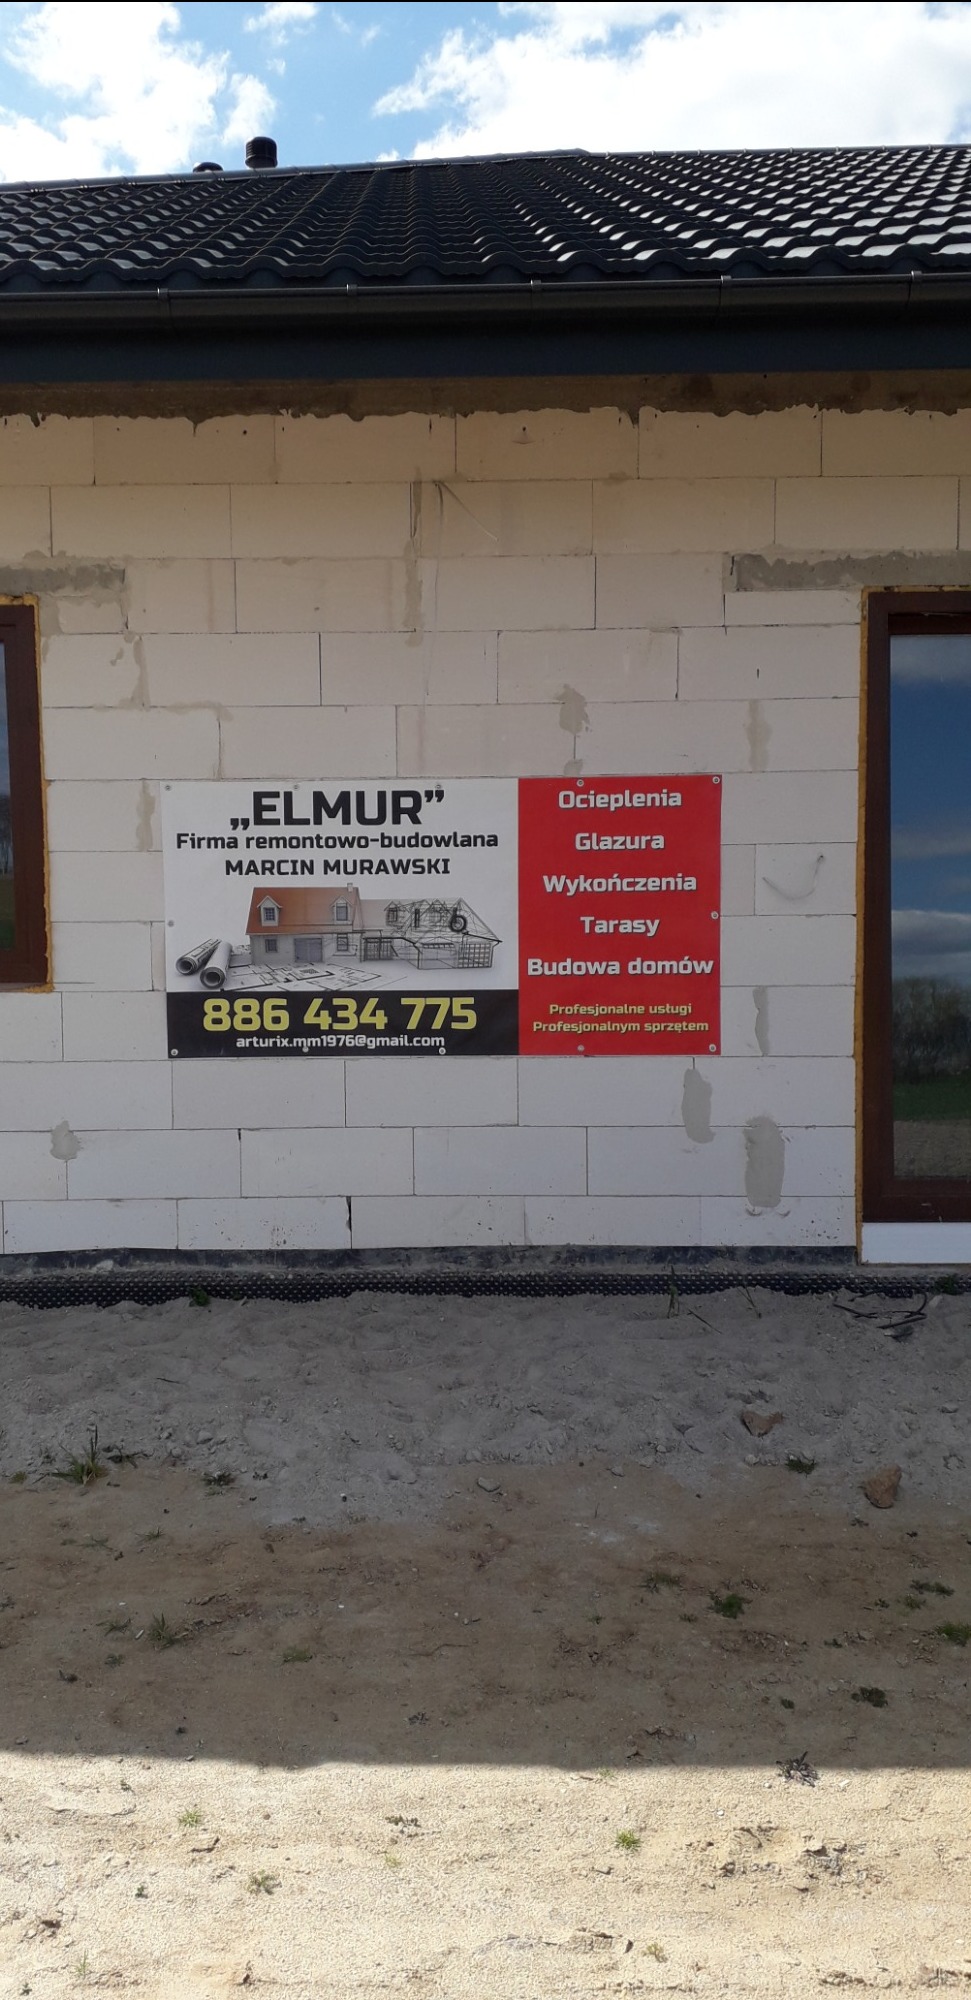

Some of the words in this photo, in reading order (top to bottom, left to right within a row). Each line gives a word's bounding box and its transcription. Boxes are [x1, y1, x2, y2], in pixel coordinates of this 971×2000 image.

[558, 789, 682, 812] Ocieplenia
[176, 833, 239, 850] Firma
[245, 831, 499, 850] remontowo-budowlana
[575, 833, 665, 851] Glazura
[225, 859, 315, 876] MARCIN
[323, 858, 451, 875] MURAWSKI
[543, 873, 697, 896] Wykończenia
[580, 916, 660, 937] Tarasy
[527, 958, 621, 976] Budowa
[627, 956, 714, 975] domów
[203, 997, 290, 1031] 886
[303, 997, 388, 1031] 434
[400, 997, 478, 1030] 775
[549, 1004, 645, 1017] Profesjonalne
[649, 1003, 692, 1017] usługi
[533, 1021, 640, 1034] Profesjonalnym
[644, 1020, 709, 1034] sprzętem
[236, 1034, 445, 1050] arturix.mm1976@gmail.com
